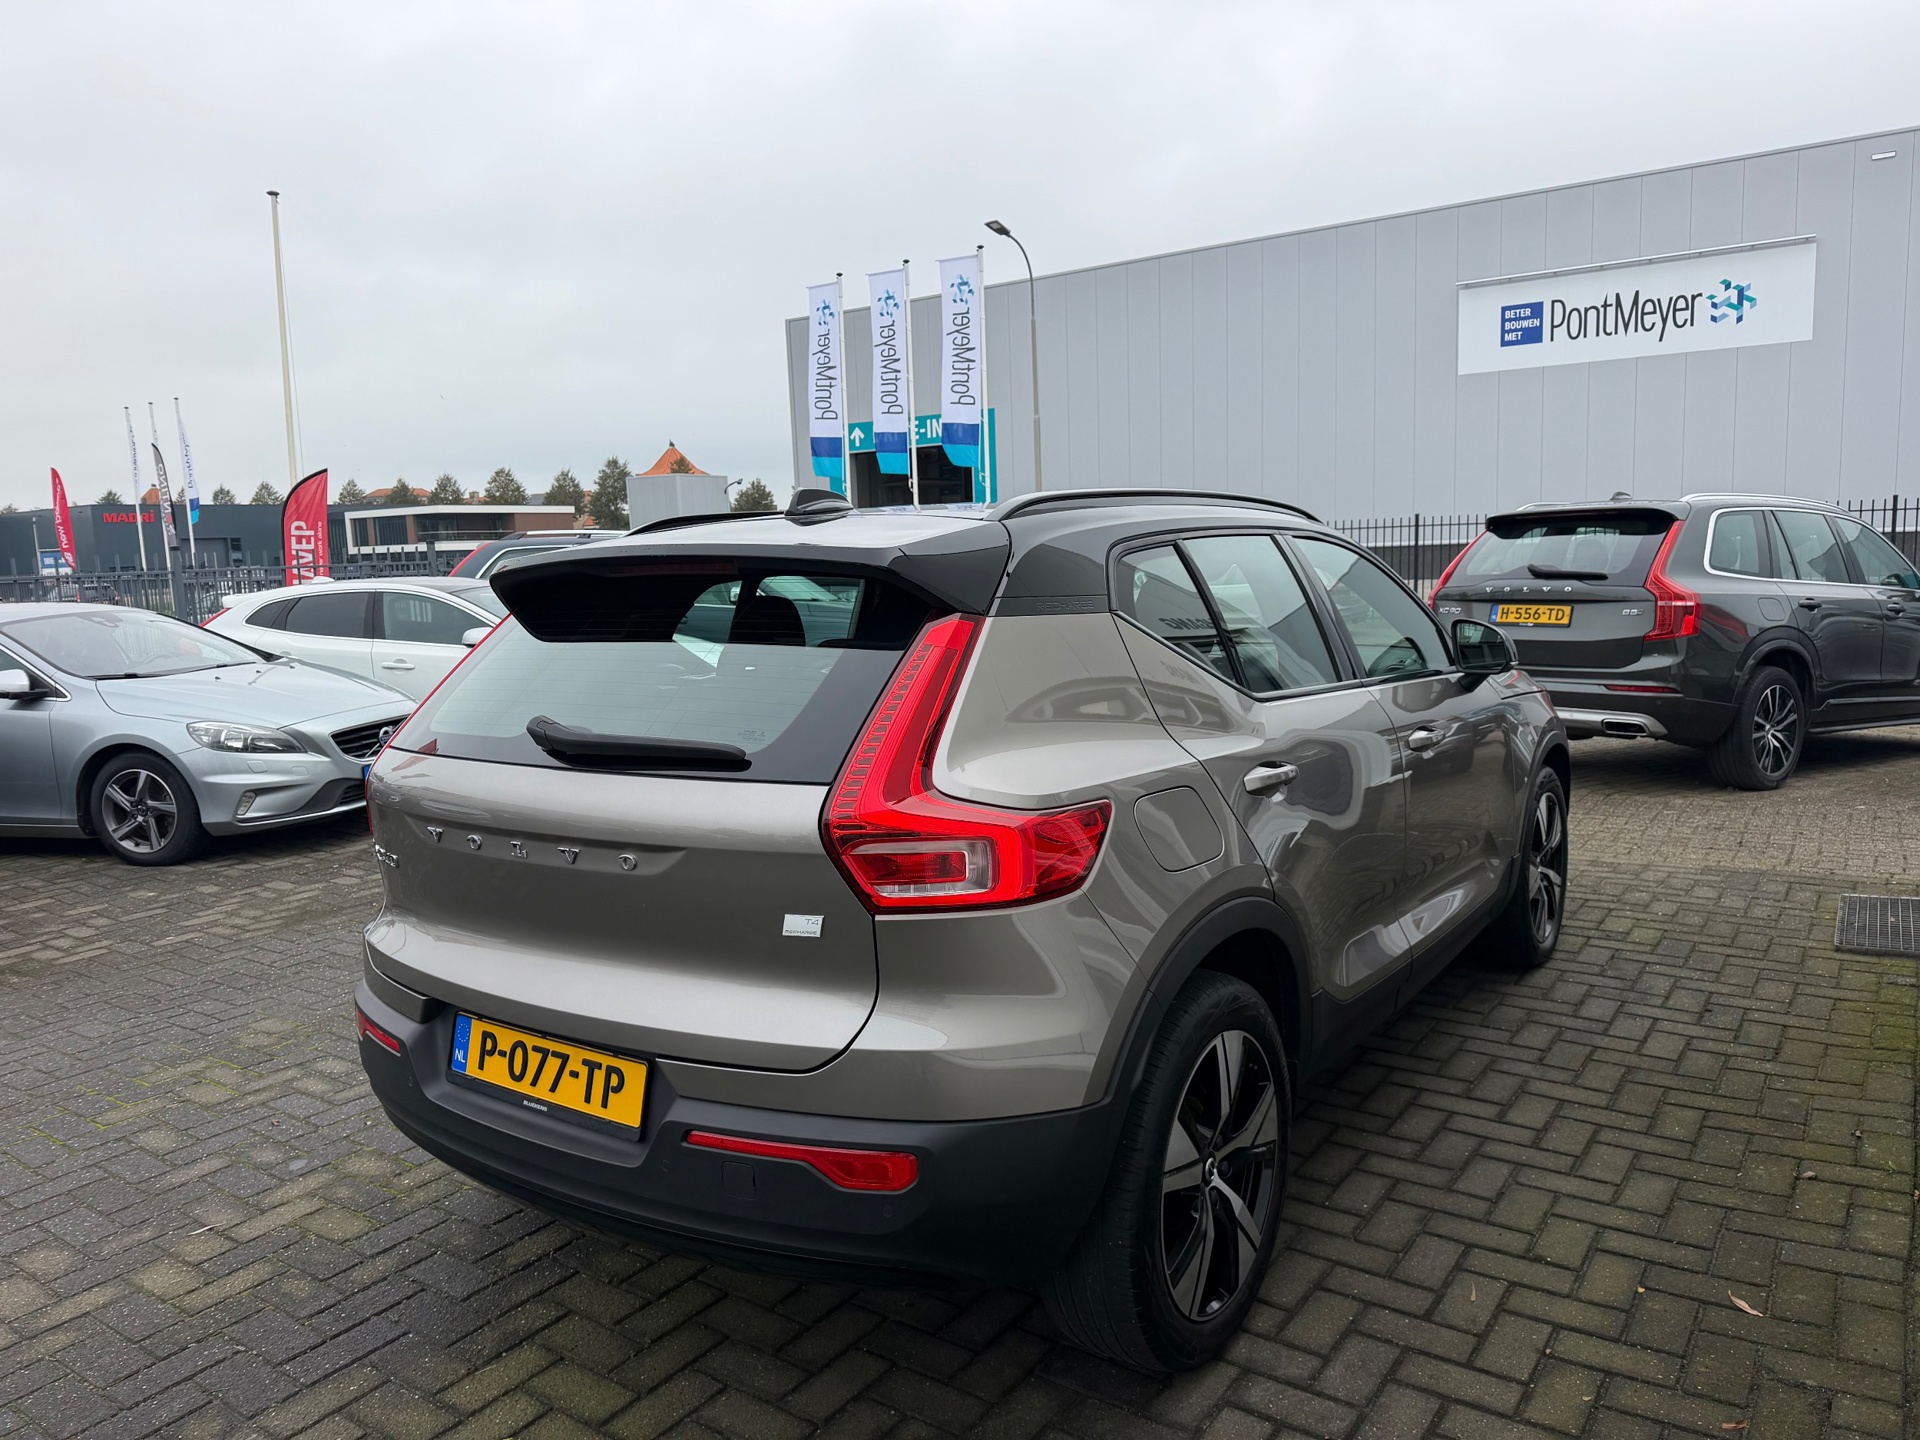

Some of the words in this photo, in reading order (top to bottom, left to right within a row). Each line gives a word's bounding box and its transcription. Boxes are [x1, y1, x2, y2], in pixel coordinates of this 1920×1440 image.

[1505, 308, 1531, 319] BETER
[1550, 290, 1703, 342] PontMeyer
[1504, 318, 1540, 330] BOUWEN
[1504, 332, 1523, 341] MET
[1500, 607, 1565, 621] H-556-TD
[426, 826, 638, 872] VOLVO
[804, 918, 820, 926] T4
[454, 1047, 467, 1064] NL
[477, 1030, 626, 1110] P-077-TP
